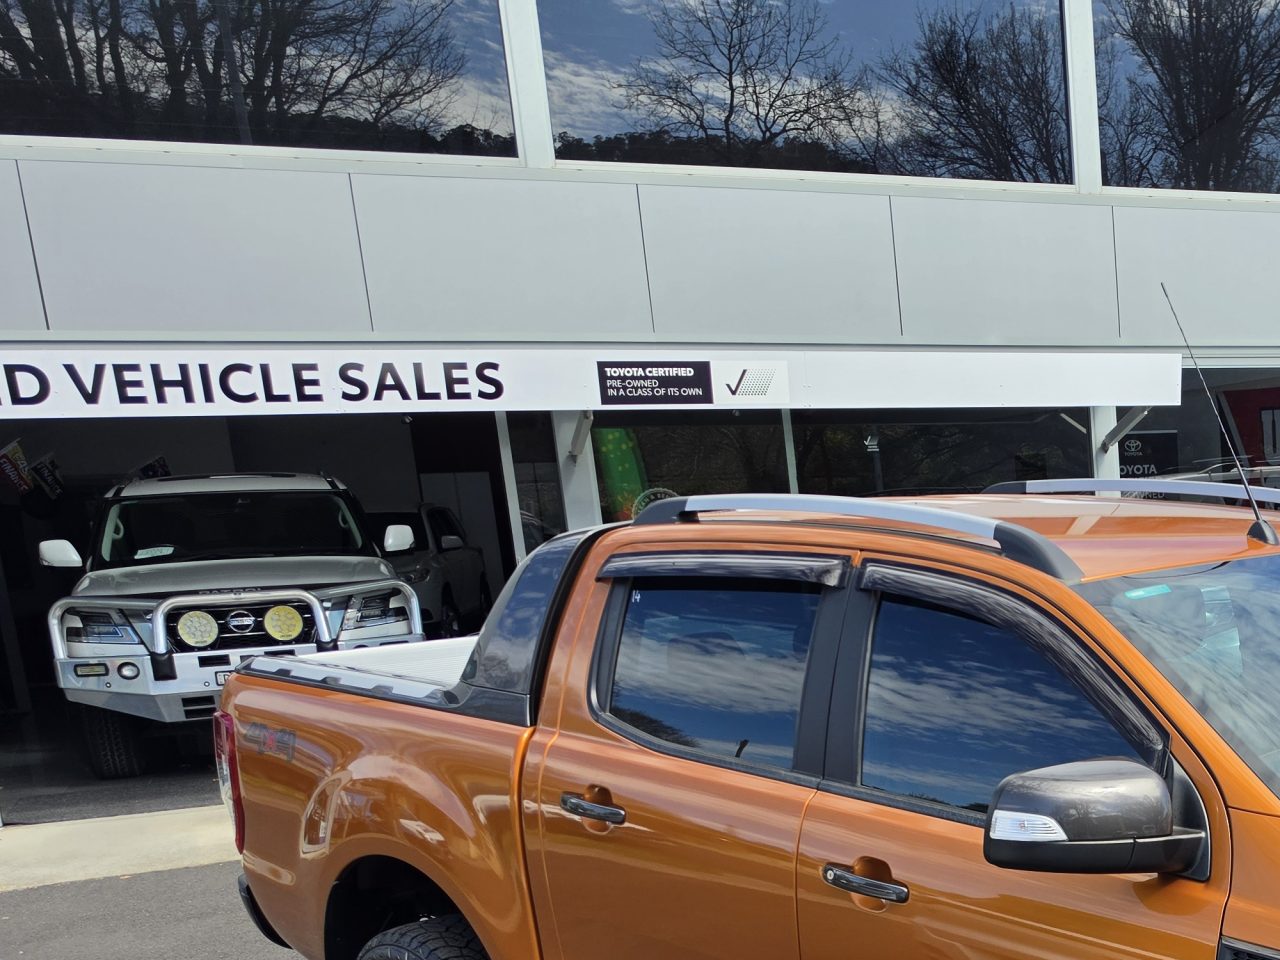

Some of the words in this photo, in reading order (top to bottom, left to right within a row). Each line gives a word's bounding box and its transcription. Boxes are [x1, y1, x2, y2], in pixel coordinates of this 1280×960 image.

[605, 367, 645, 377] TOYOTA
[646, 367, 694, 377] CERTIFIED
[0, 363, 51, 406] D
[62, 363, 324, 405] VEHICLE
[338, 362, 504, 401] SALES
[606, 379, 659, 388] PRE-OWNED
[607, 388, 617, 396] IN
[619, 388, 625, 396] A
[626, 388, 652, 396] CLASS
[681, 388, 702, 396] OWN
[1120, 464, 1157, 475] OYOTA
